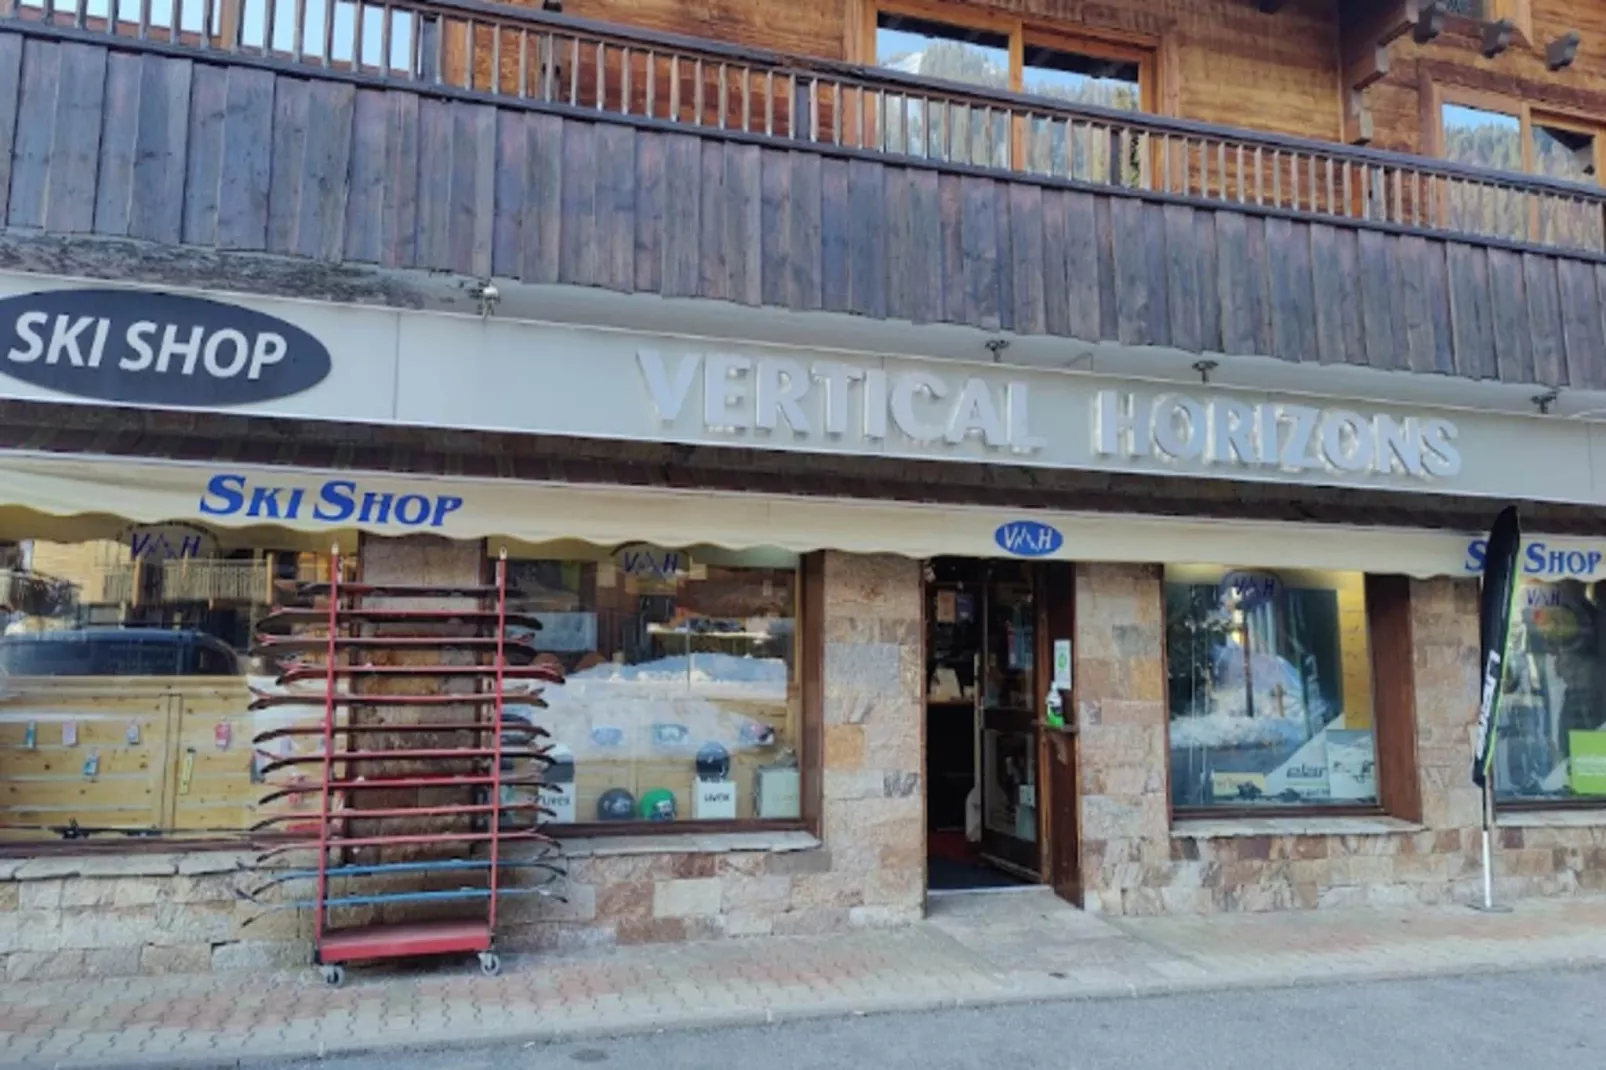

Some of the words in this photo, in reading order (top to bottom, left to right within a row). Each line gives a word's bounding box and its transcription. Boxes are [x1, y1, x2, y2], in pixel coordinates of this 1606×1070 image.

[8, 311, 110, 368] SKI
[119, 320, 288, 380] SHOP
[636, 347, 1046, 453] VERTICAL
[1093, 389, 1462, 481] HORIZONS
